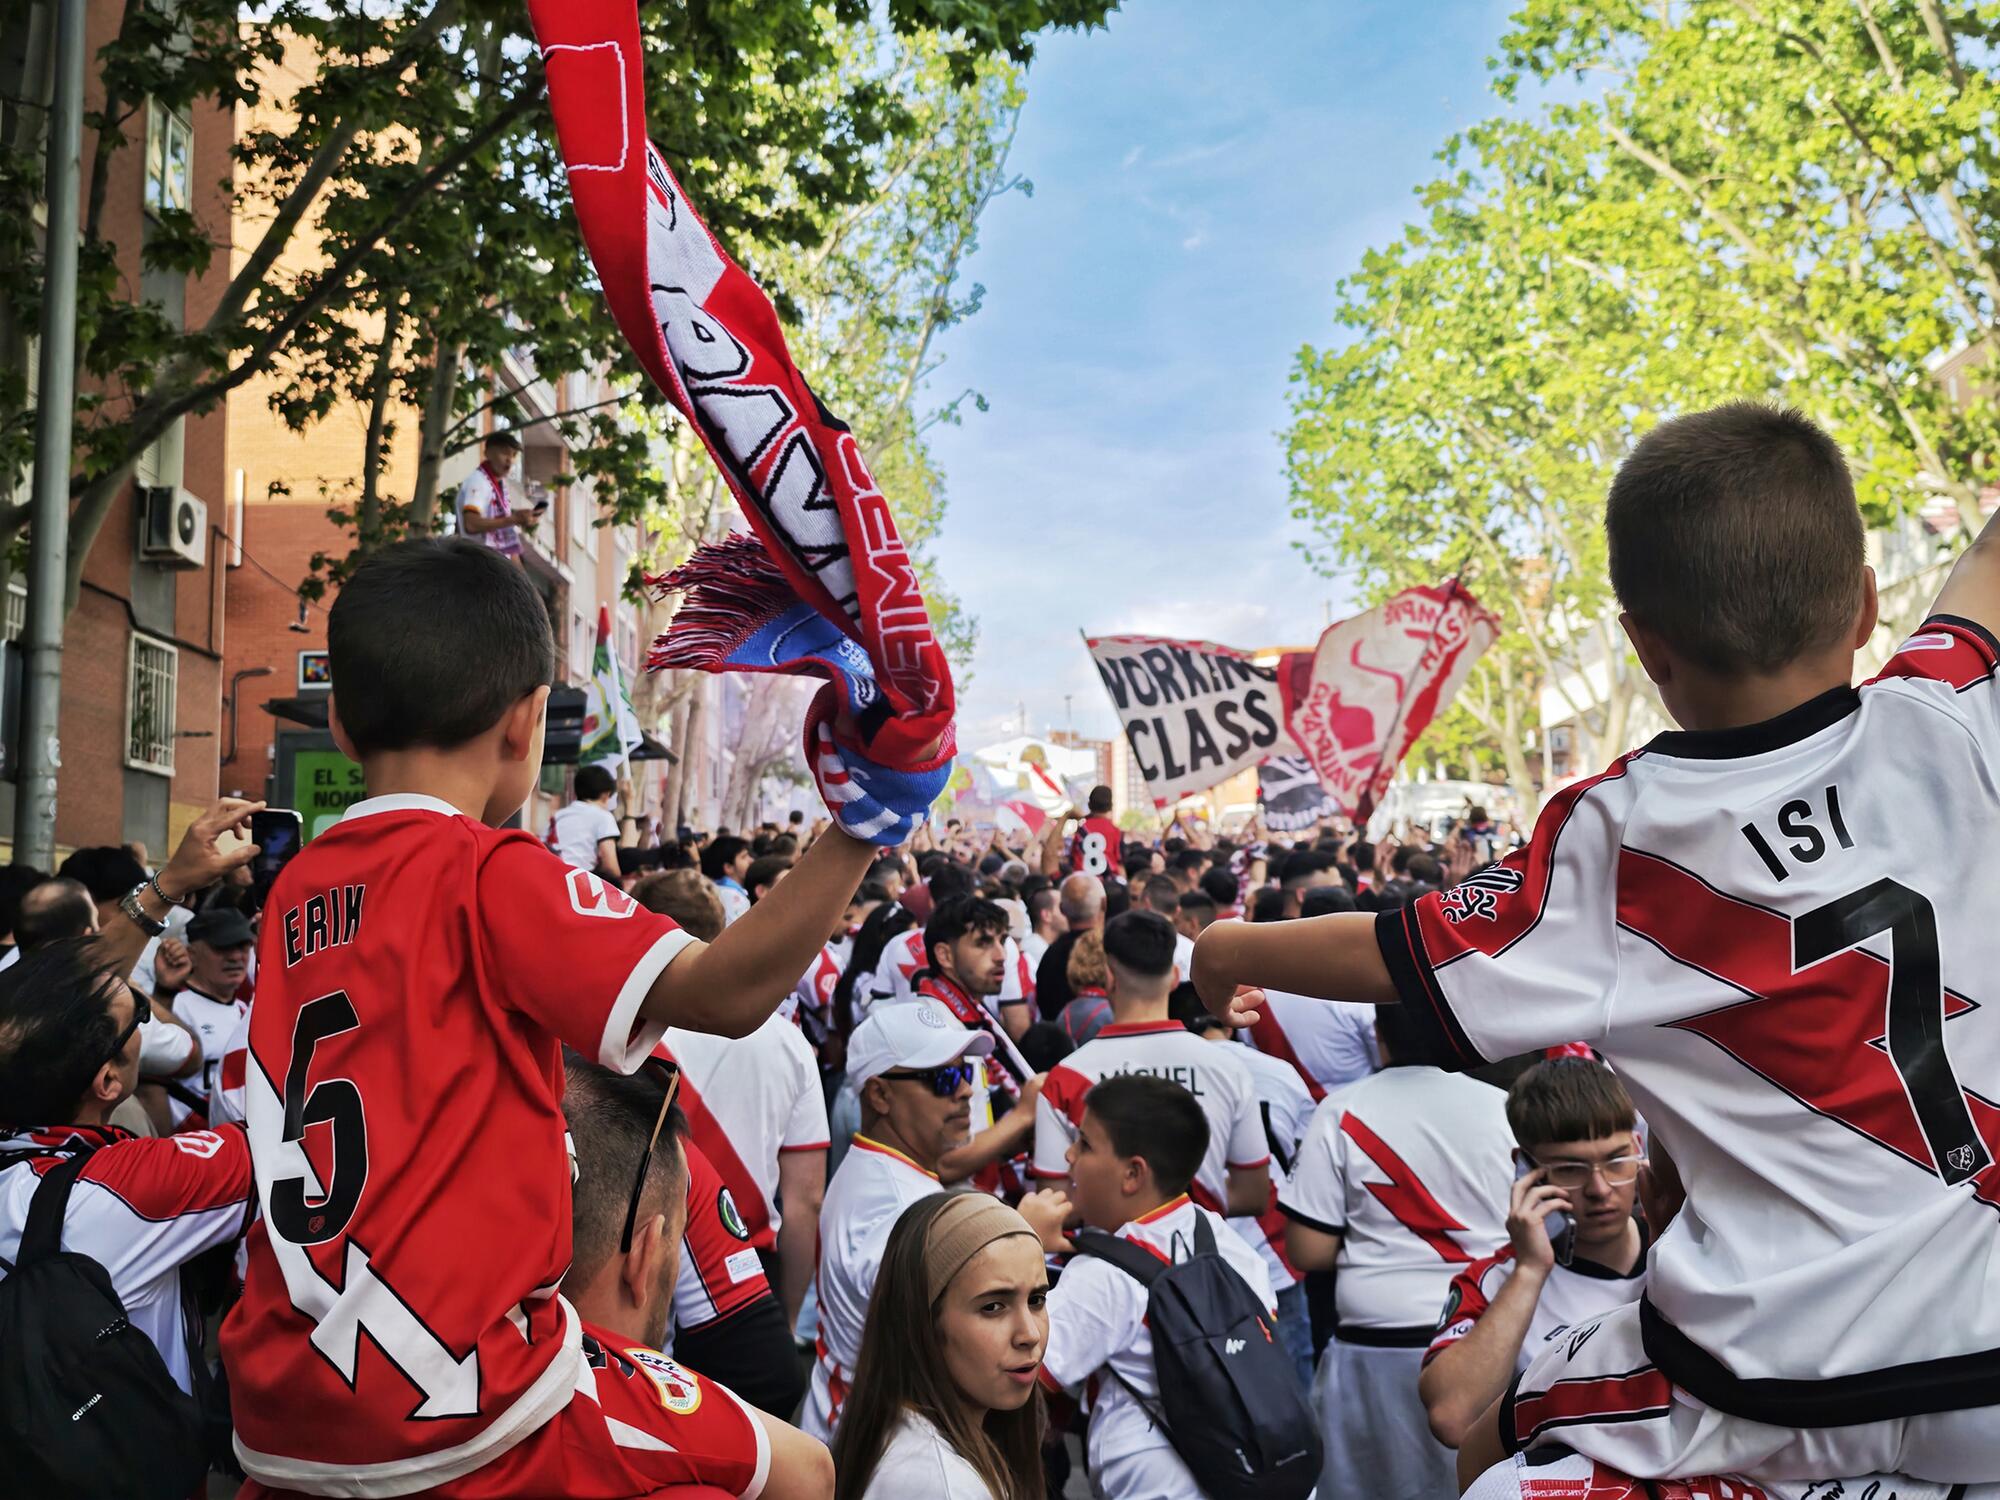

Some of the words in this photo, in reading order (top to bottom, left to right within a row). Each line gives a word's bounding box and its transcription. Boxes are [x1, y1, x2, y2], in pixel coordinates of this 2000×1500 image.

[314, 768, 337, 786] EL
[347, 768, 366, 787] S
[1126, 689, 1278, 781] CLASS
[1083, 832, 1107, 876] 8
[1740, 784, 1856, 883] ISI
[283, 884, 366, 969] ERIK
[1790, 876, 1996, 1188] 7
[269, 989, 369, 1245] 5
